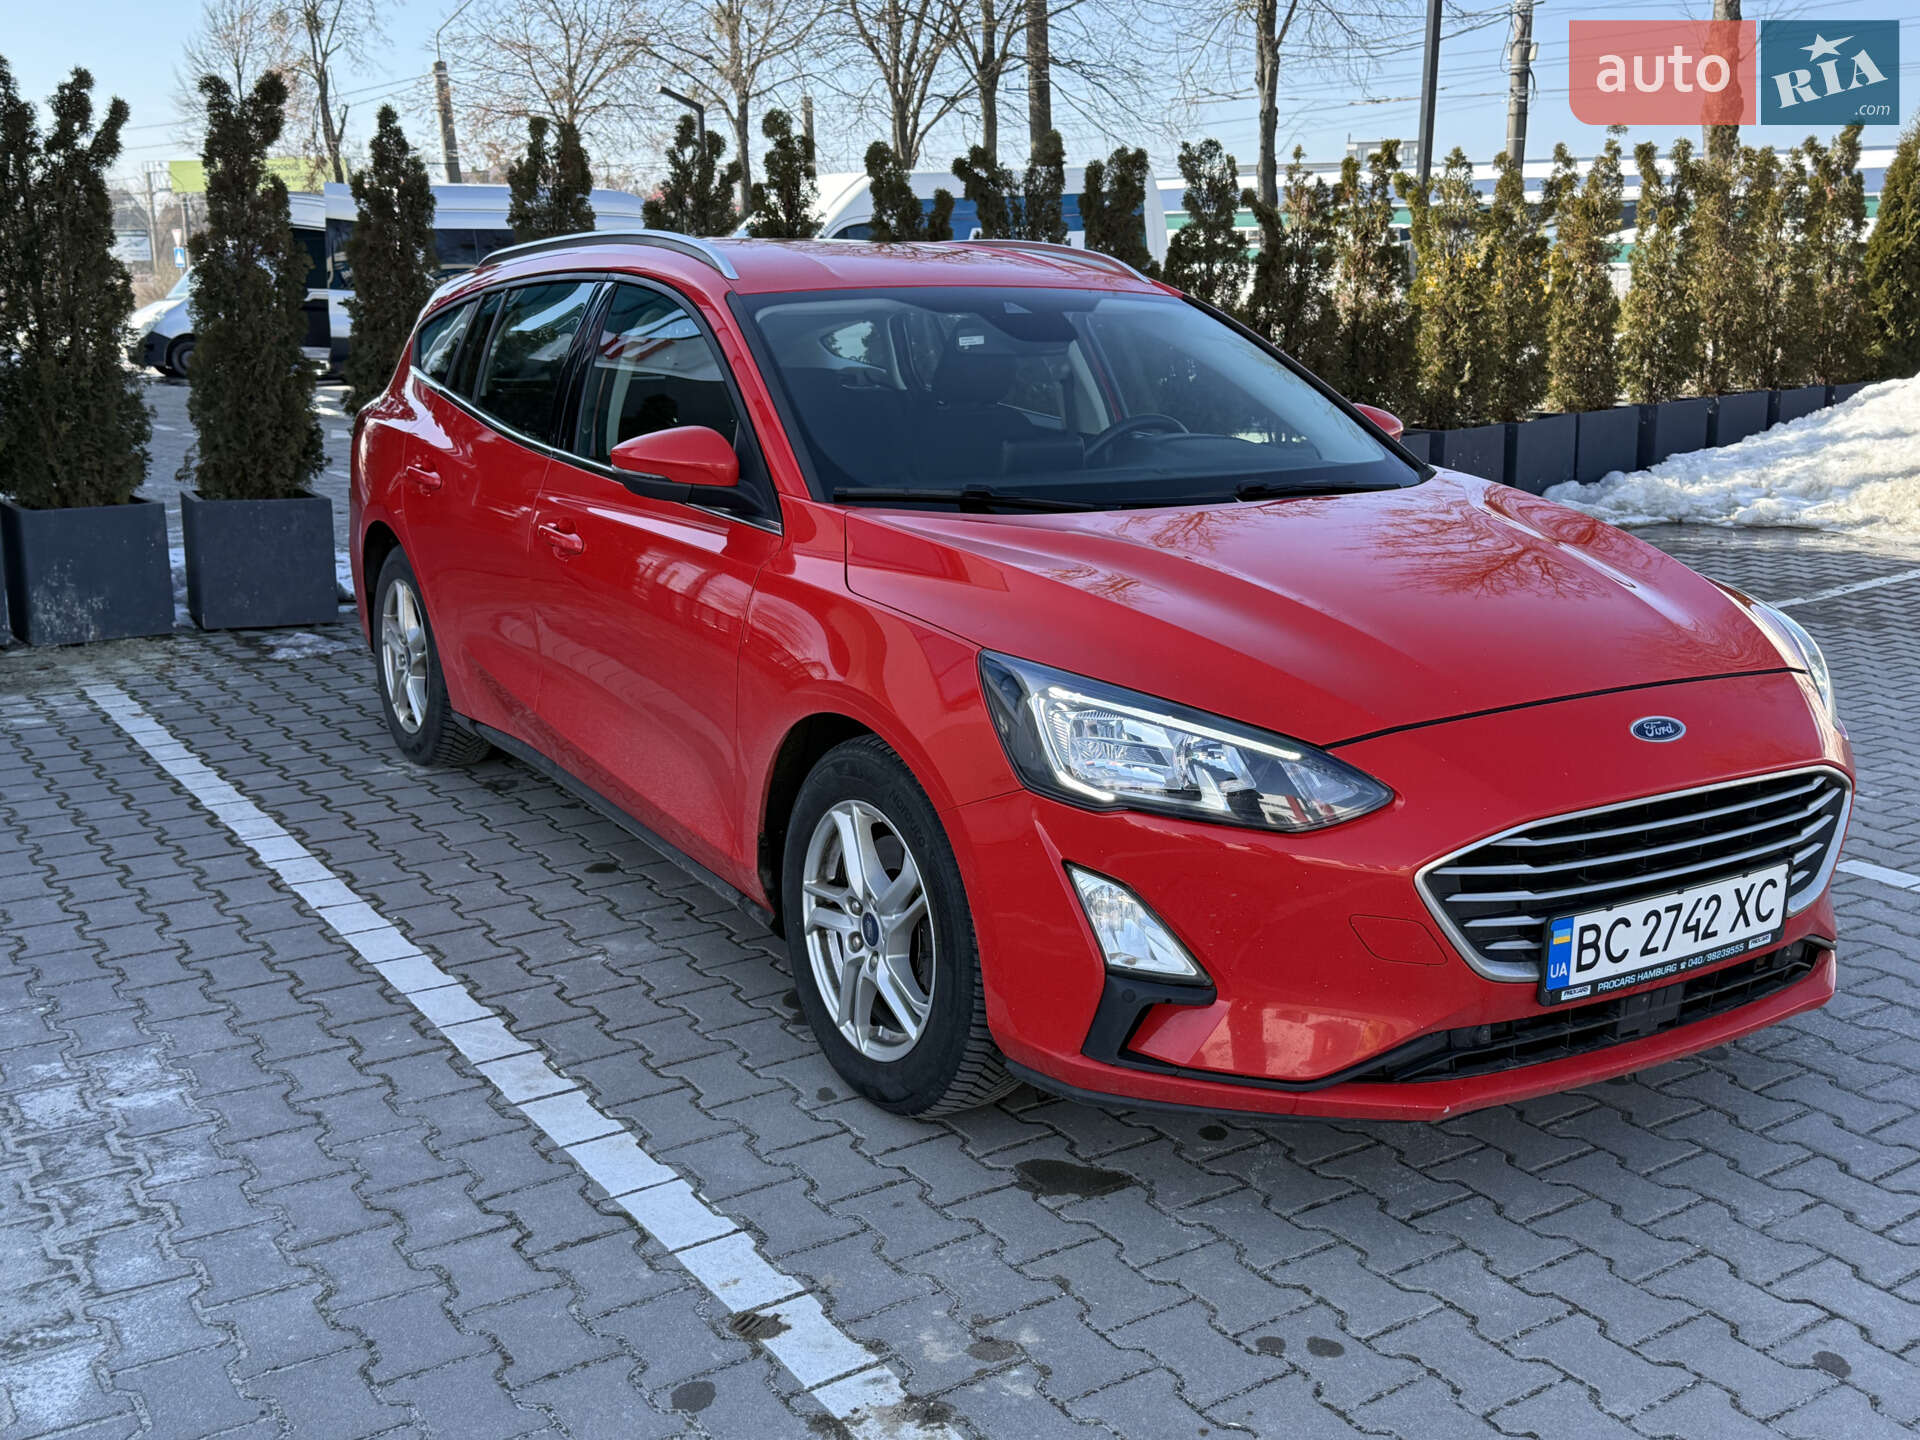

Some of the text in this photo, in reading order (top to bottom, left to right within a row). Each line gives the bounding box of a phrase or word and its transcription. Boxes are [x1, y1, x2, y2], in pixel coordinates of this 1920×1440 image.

[1643, 721, 1675, 737] Ford
[1576, 878, 1778, 973] BC 2742 XC
[1550, 962, 1568, 979] UA
[1597, 974, 1636, 992] PROCARS
[1637, 963, 1677, 982] HAMBURG
